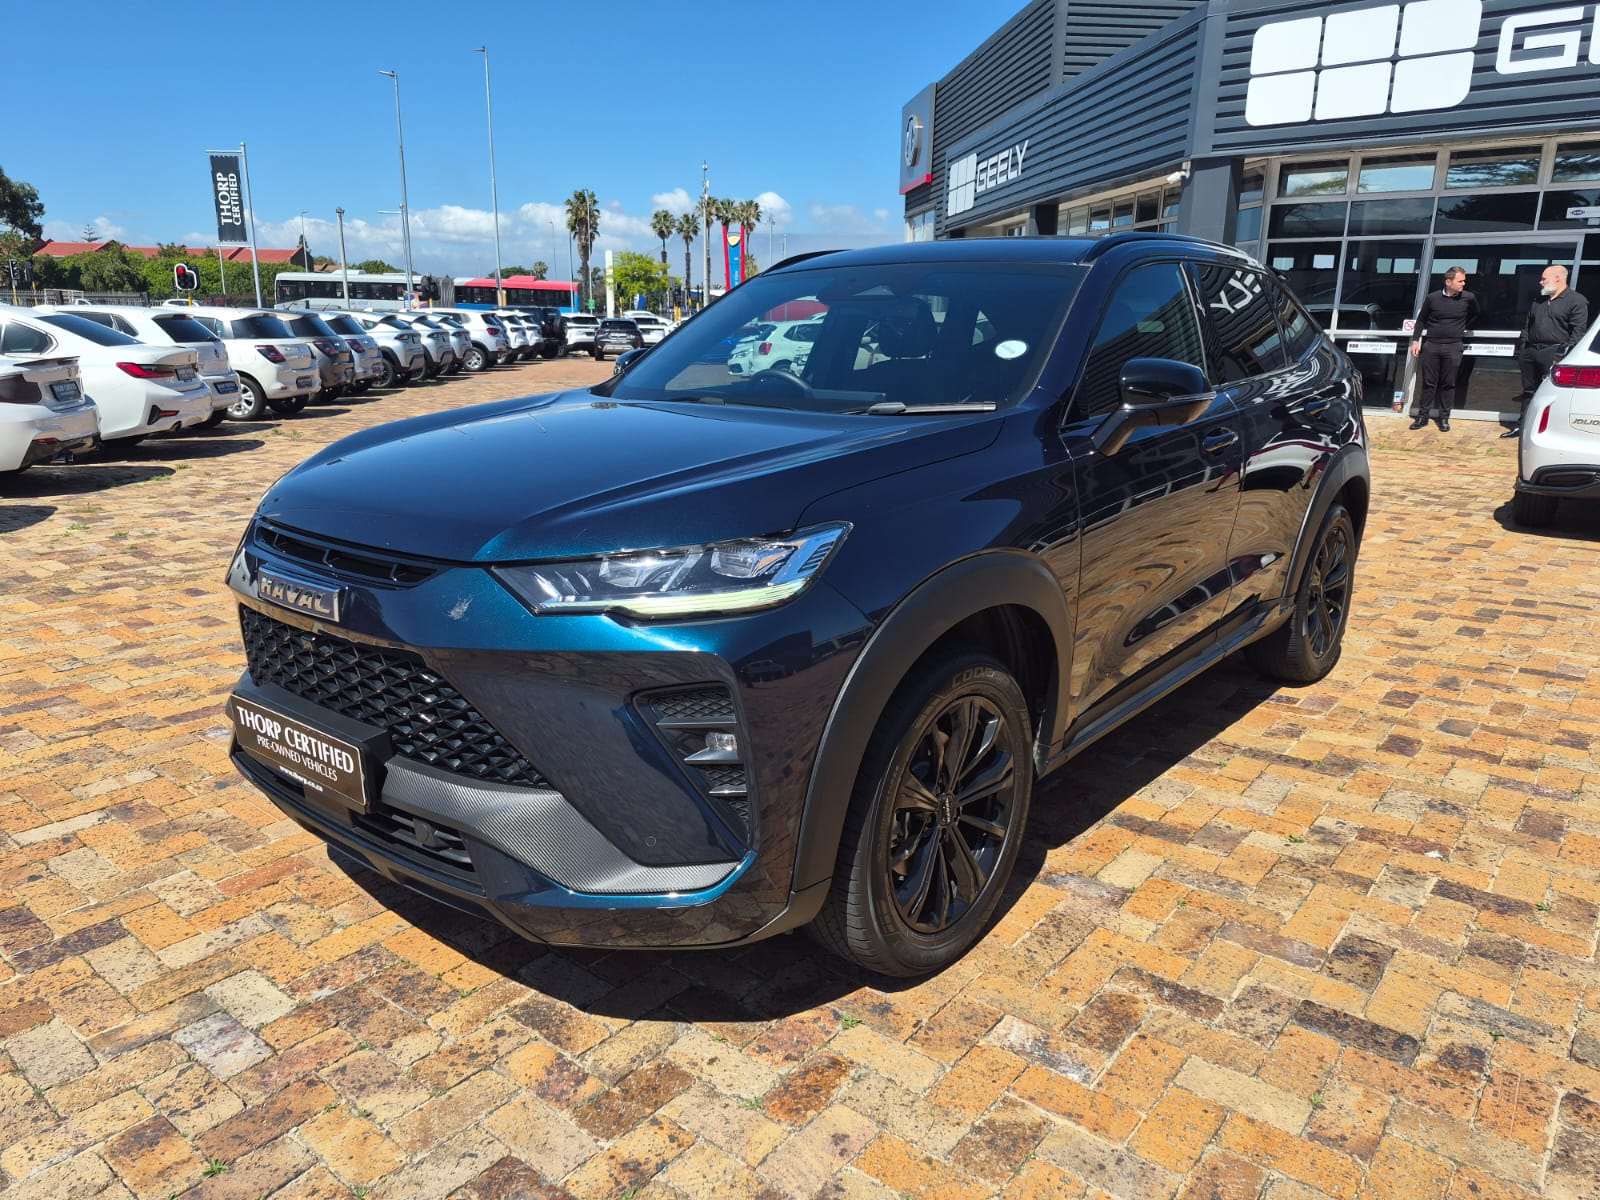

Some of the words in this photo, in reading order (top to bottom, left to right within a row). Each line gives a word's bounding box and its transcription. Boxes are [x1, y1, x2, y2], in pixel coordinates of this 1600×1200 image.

[1495, 4, 1600, 75] G
[976, 139, 1029, 192] GEELY
[216, 172, 233, 226] THORP
[228, 172, 242, 226] CERTIFIED
[260, 577, 330, 614] HAVAL
[236, 705, 282, 740] THORP
[284, 726, 354, 774] CERTIFIED
[256, 734, 301, 763] PRE-OWNED
[301, 755, 338, 782] VEHICLES
